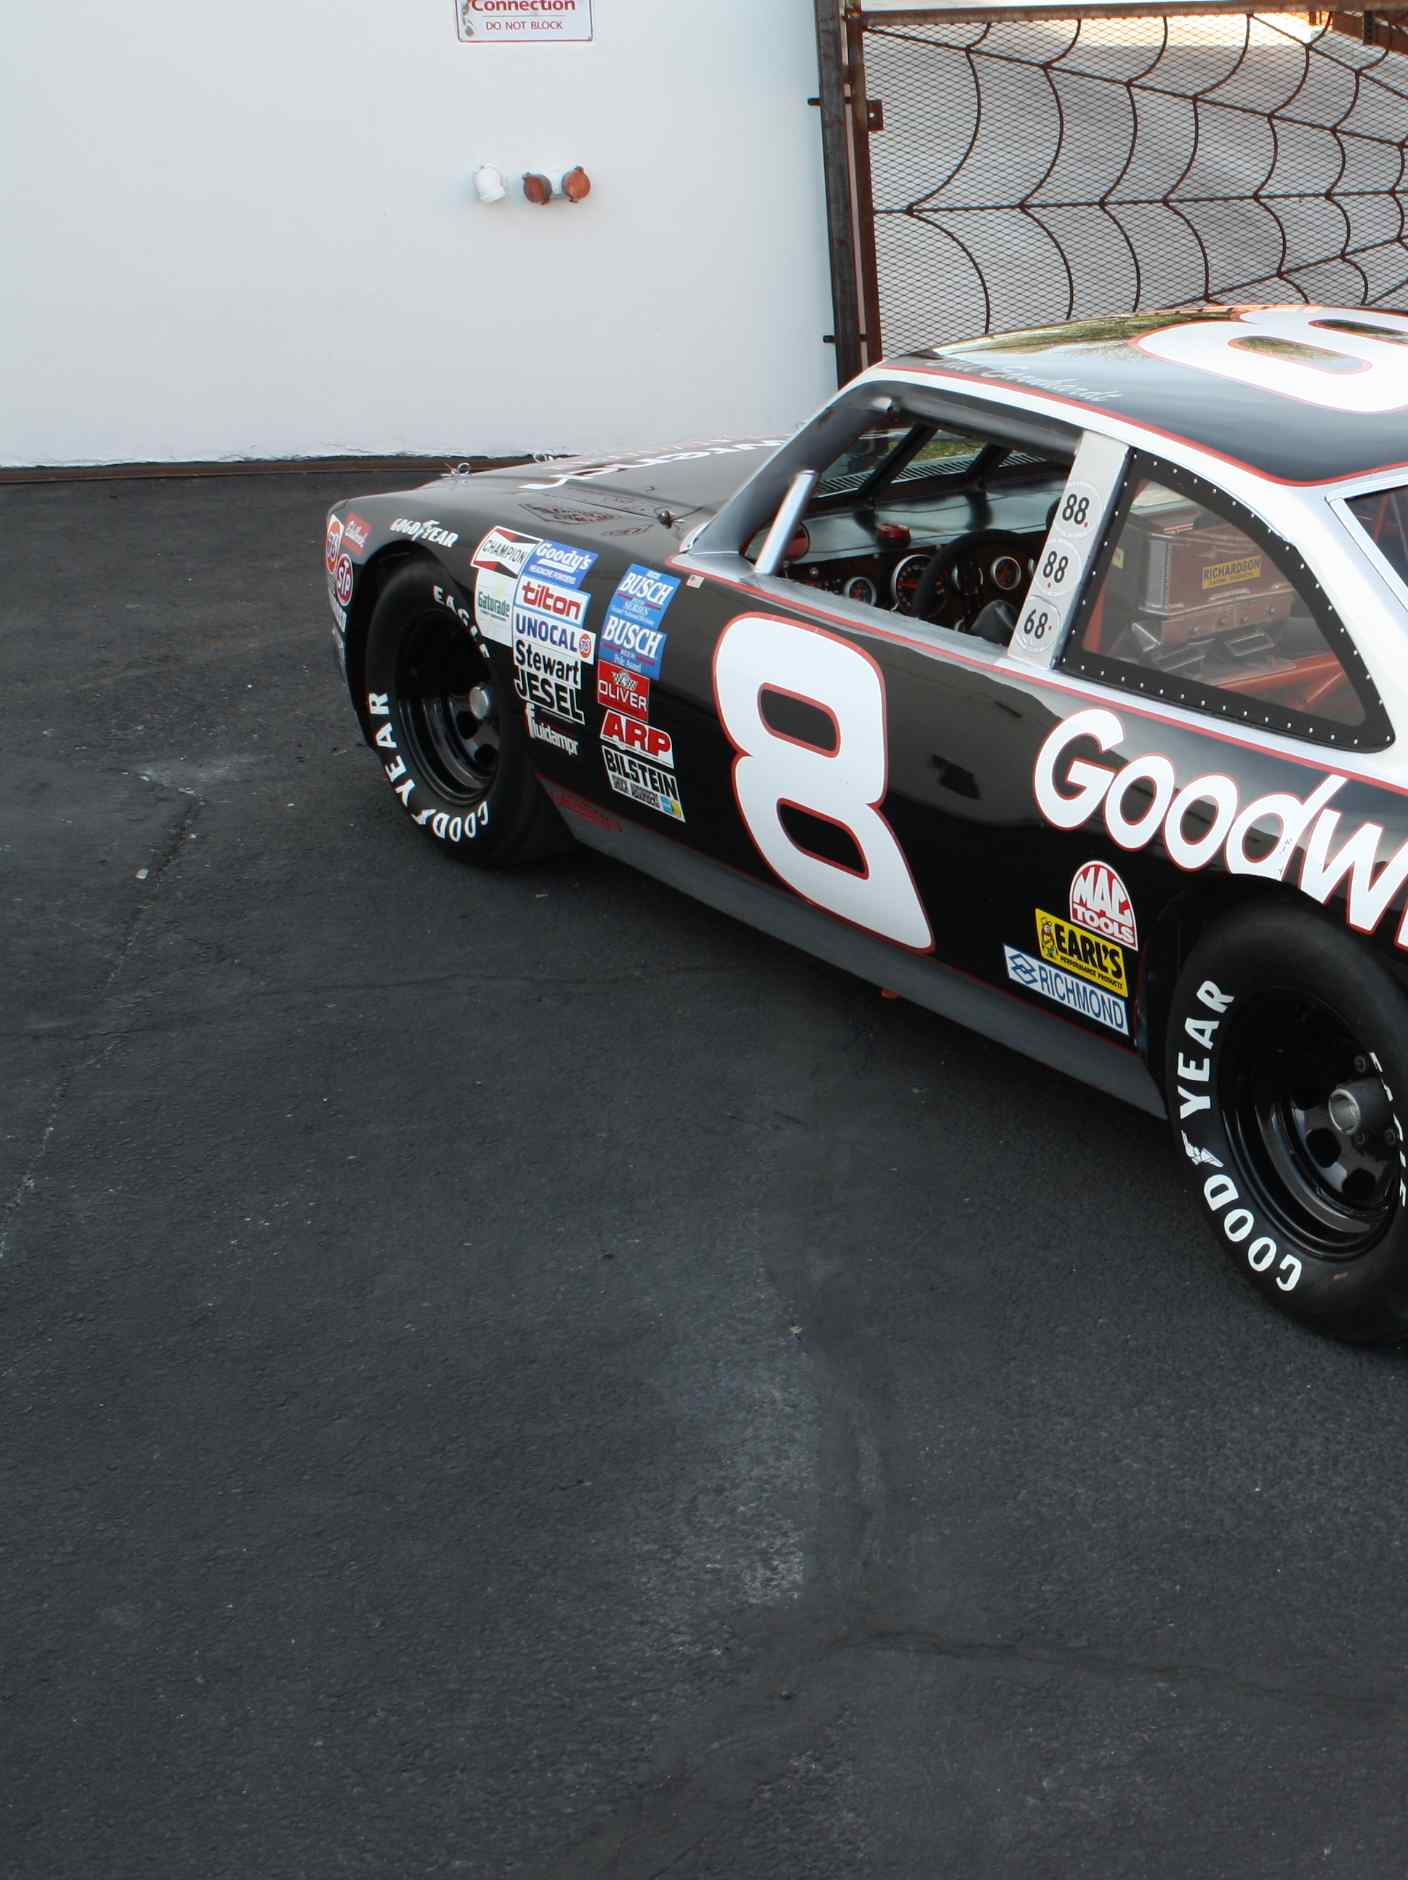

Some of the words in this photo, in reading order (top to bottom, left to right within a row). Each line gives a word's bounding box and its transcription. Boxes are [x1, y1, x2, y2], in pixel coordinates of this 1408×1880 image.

[471, 0, 576, 11] Connection
[486, 21, 500, 30] DO
[505, 20, 526, 30] NOT
[531, 20, 563, 30] BLOCK
[1062, 493, 1090, 525] 88
[482, 540, 527, 563] CHAMPION
[536, 542, 593, 571] Goody's
[1043, 551, 1068, 583] 88
[338, 561, 351, 596] STP
[618, 572, 674, 605] BUSCH
[522, 581, 582, 620] tilton
[516, 613, 578, 652] UNOCAL
[601, 615, 663, 659] BUSCH
[1024, 608, 1048, 639] 68
[515, 639, 580, 686] Stewart
[514, 668, 585, 725] JESEL
[599, 680, 647, 712] OLIVER
[602, 713, 672, 758] ARP
[605, 748, 679, 801] BILSTEIN
[713, 612, 935, 953] 8
[1072, 865, 1132, 928] MAC
[1072, 904, 1136, 944] TOOLS
[1055, 923, 1124, 979] EARL'S
[1038, 964, 1124, 1030] RICHMOND
